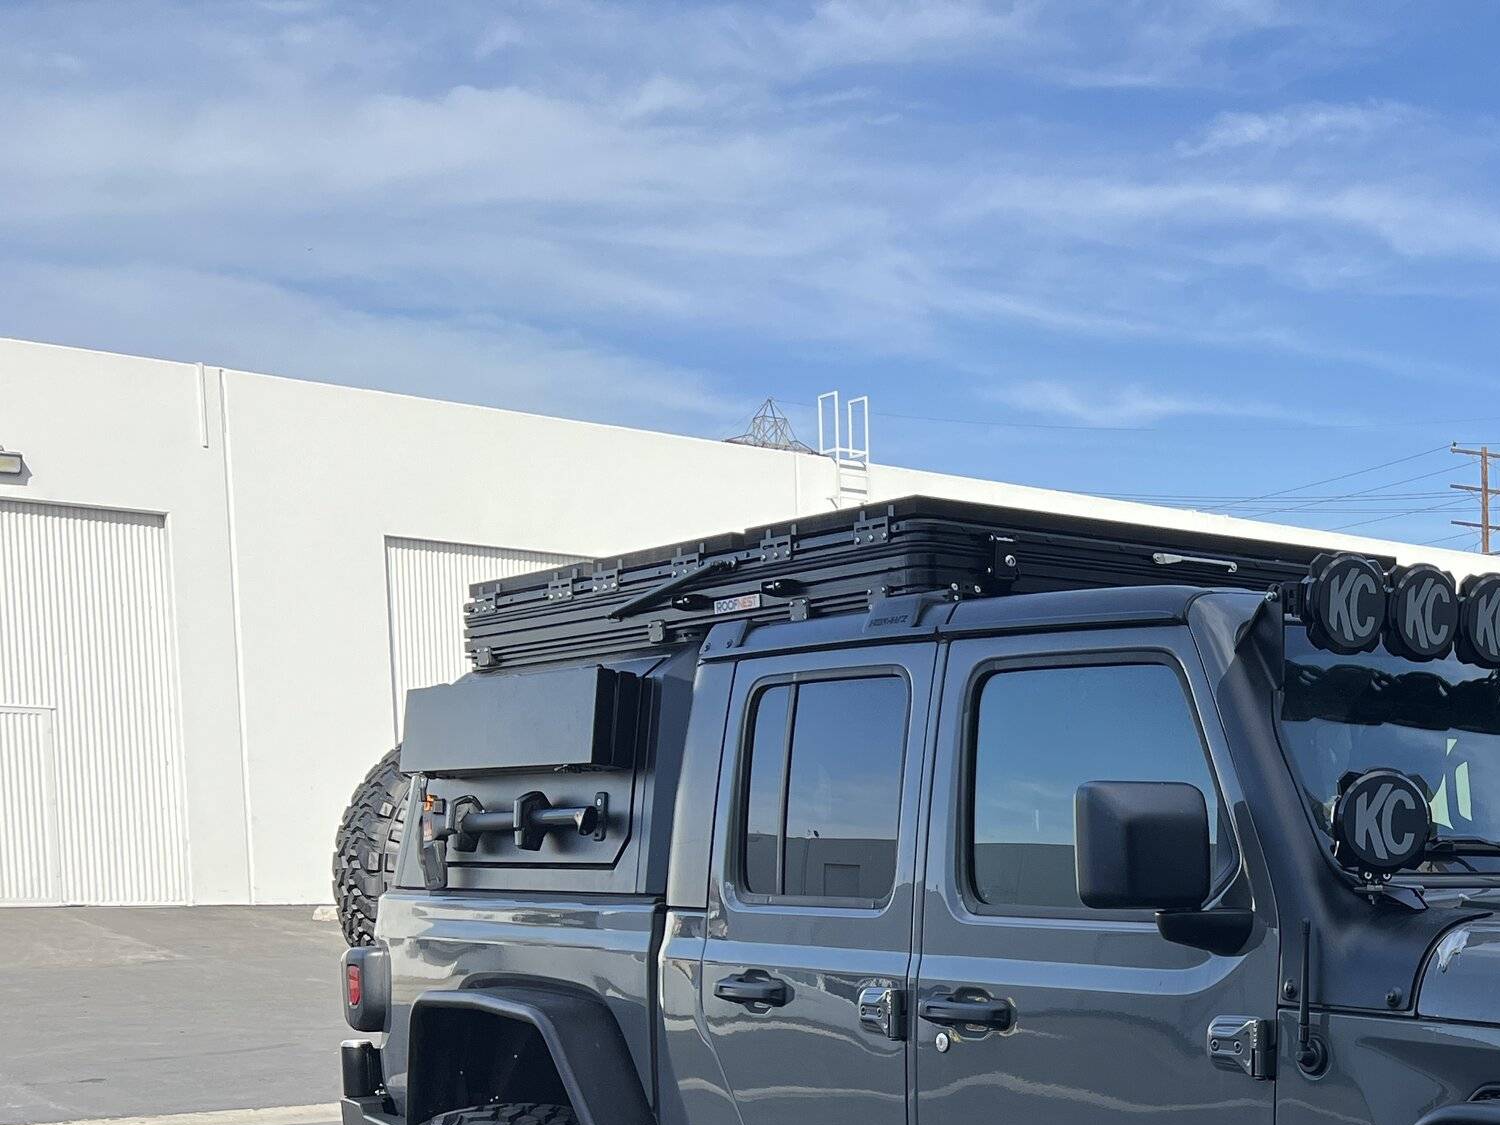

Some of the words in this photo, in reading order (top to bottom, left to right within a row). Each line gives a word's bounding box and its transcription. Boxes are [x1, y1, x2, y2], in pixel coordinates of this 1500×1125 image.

[716, 595, 757, 612] ROOFNEST
[1329, 568, 1377, 642] KC
[1405, 577, 1451, 648] KC
[1355, 783, 1415, 860] KC
